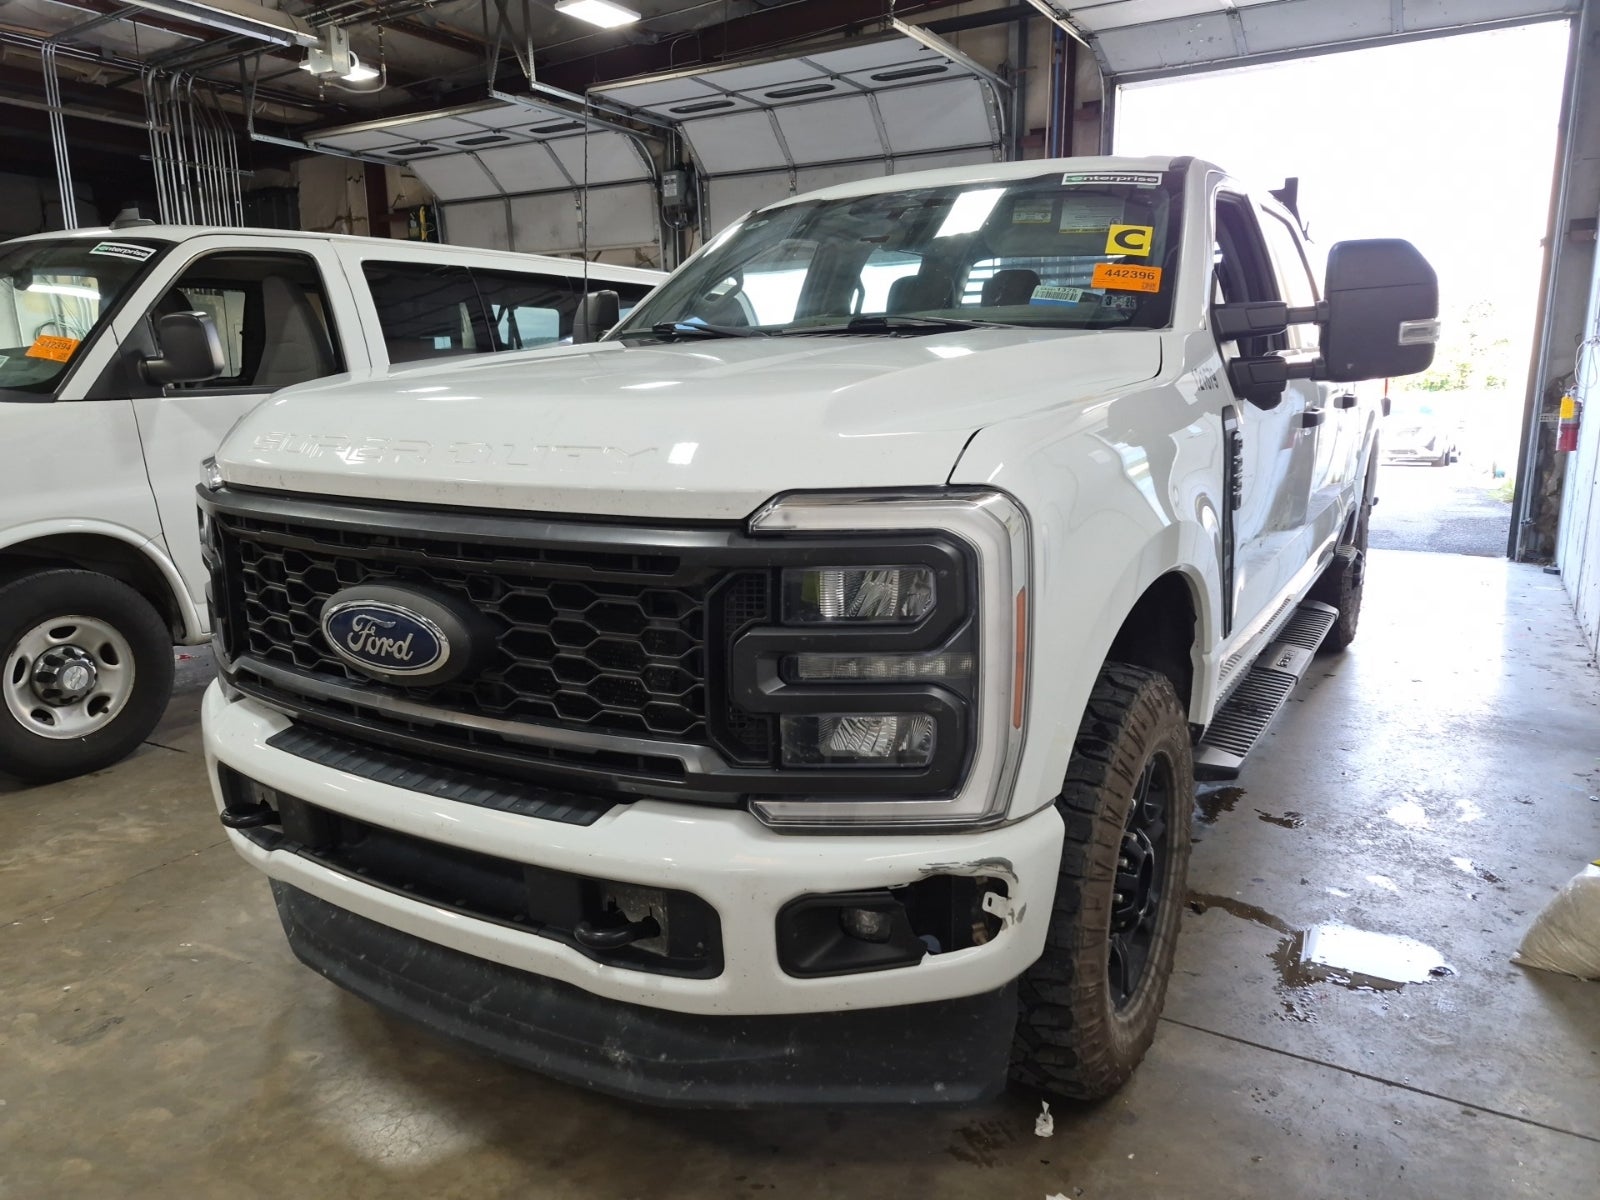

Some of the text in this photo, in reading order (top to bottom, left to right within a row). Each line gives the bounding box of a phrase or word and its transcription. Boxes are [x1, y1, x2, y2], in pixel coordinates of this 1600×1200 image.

[1067, 174, 1158, 183] enterprise
[1113, 228, 1147, 250] C
[97, 246, 150, 257] enterprise
[1104, 269, 1156, 280] 442396
[346, 614, 414, 661] Ford
